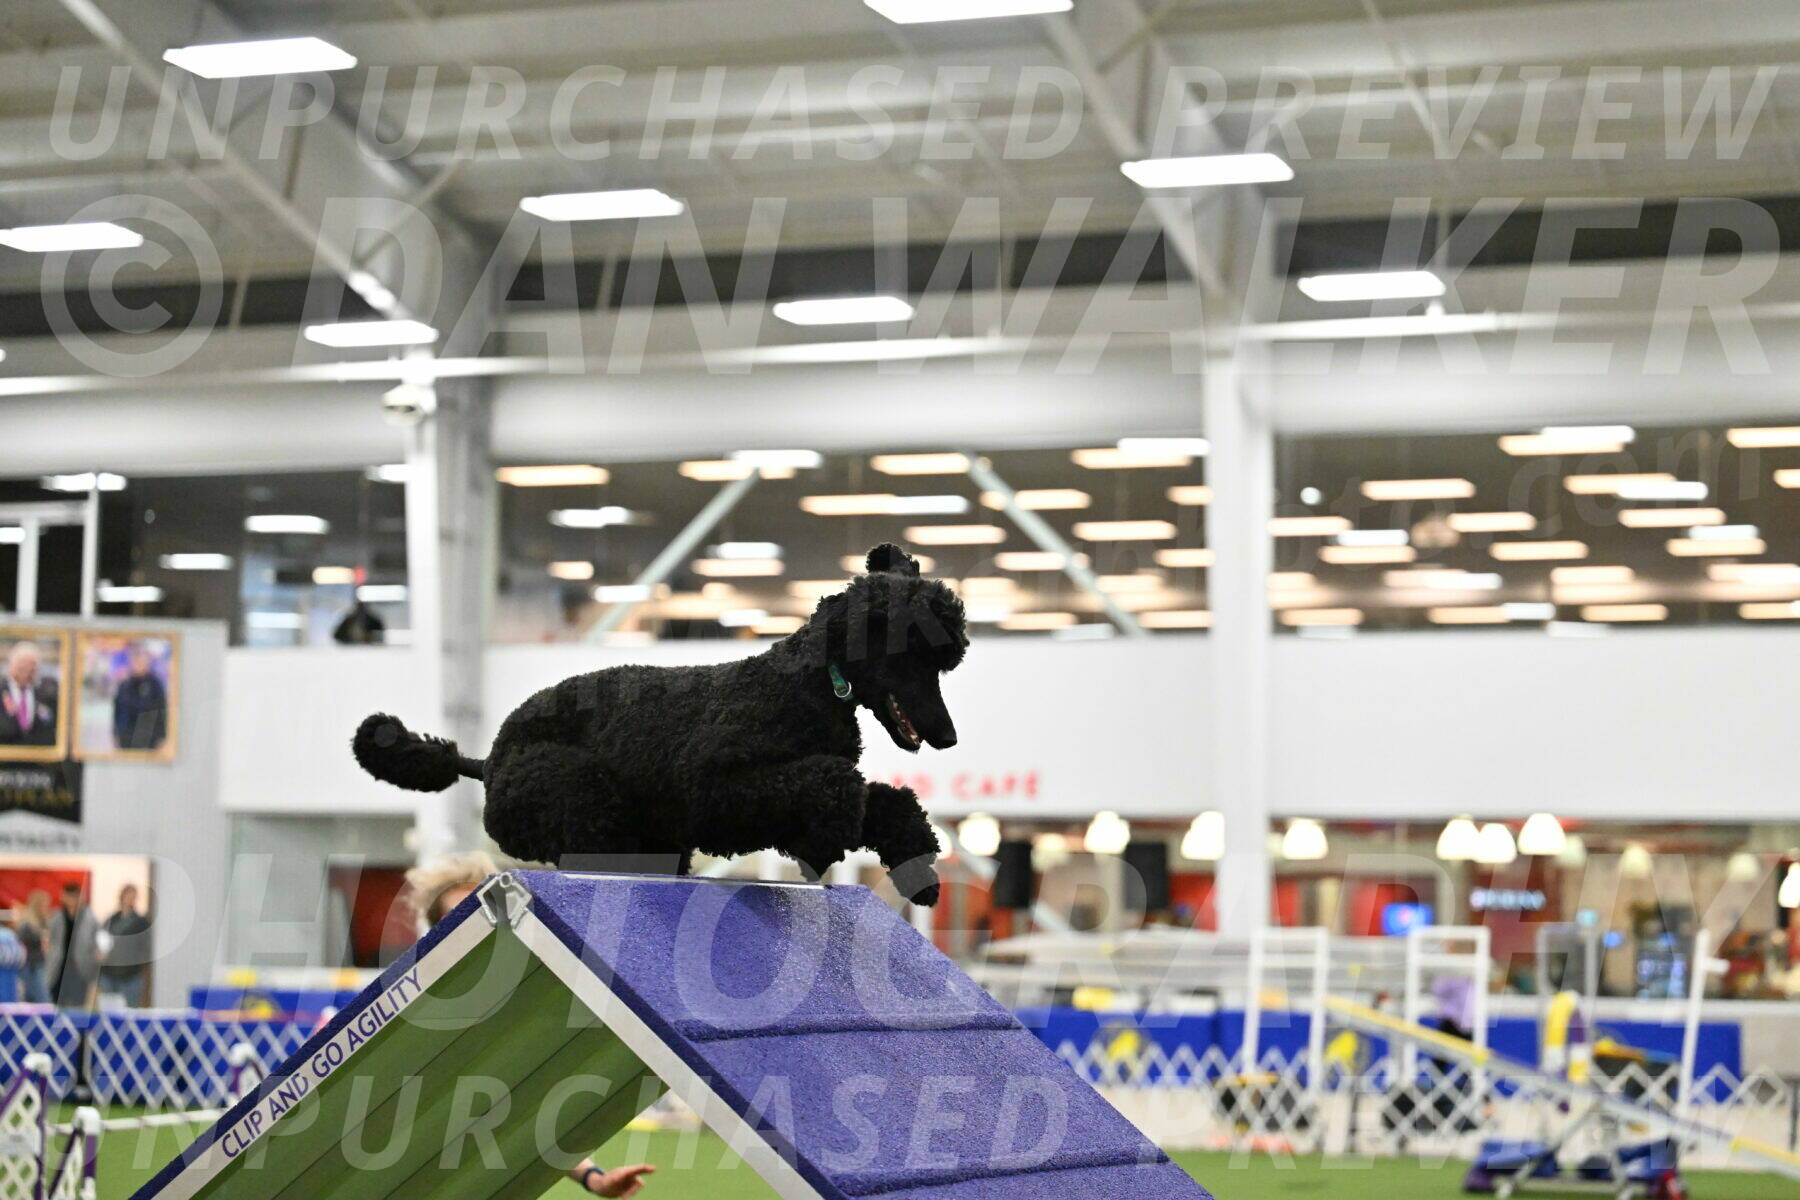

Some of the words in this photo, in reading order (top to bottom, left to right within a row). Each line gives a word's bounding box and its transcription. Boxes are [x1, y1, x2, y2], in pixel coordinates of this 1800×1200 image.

[221, 1110, 263, 1158] CLIP
[267, 1073, 309, 1121] AND
[311, 1042, 344, 1078] GO
[346, 967, 423, 1052] AGILITY
